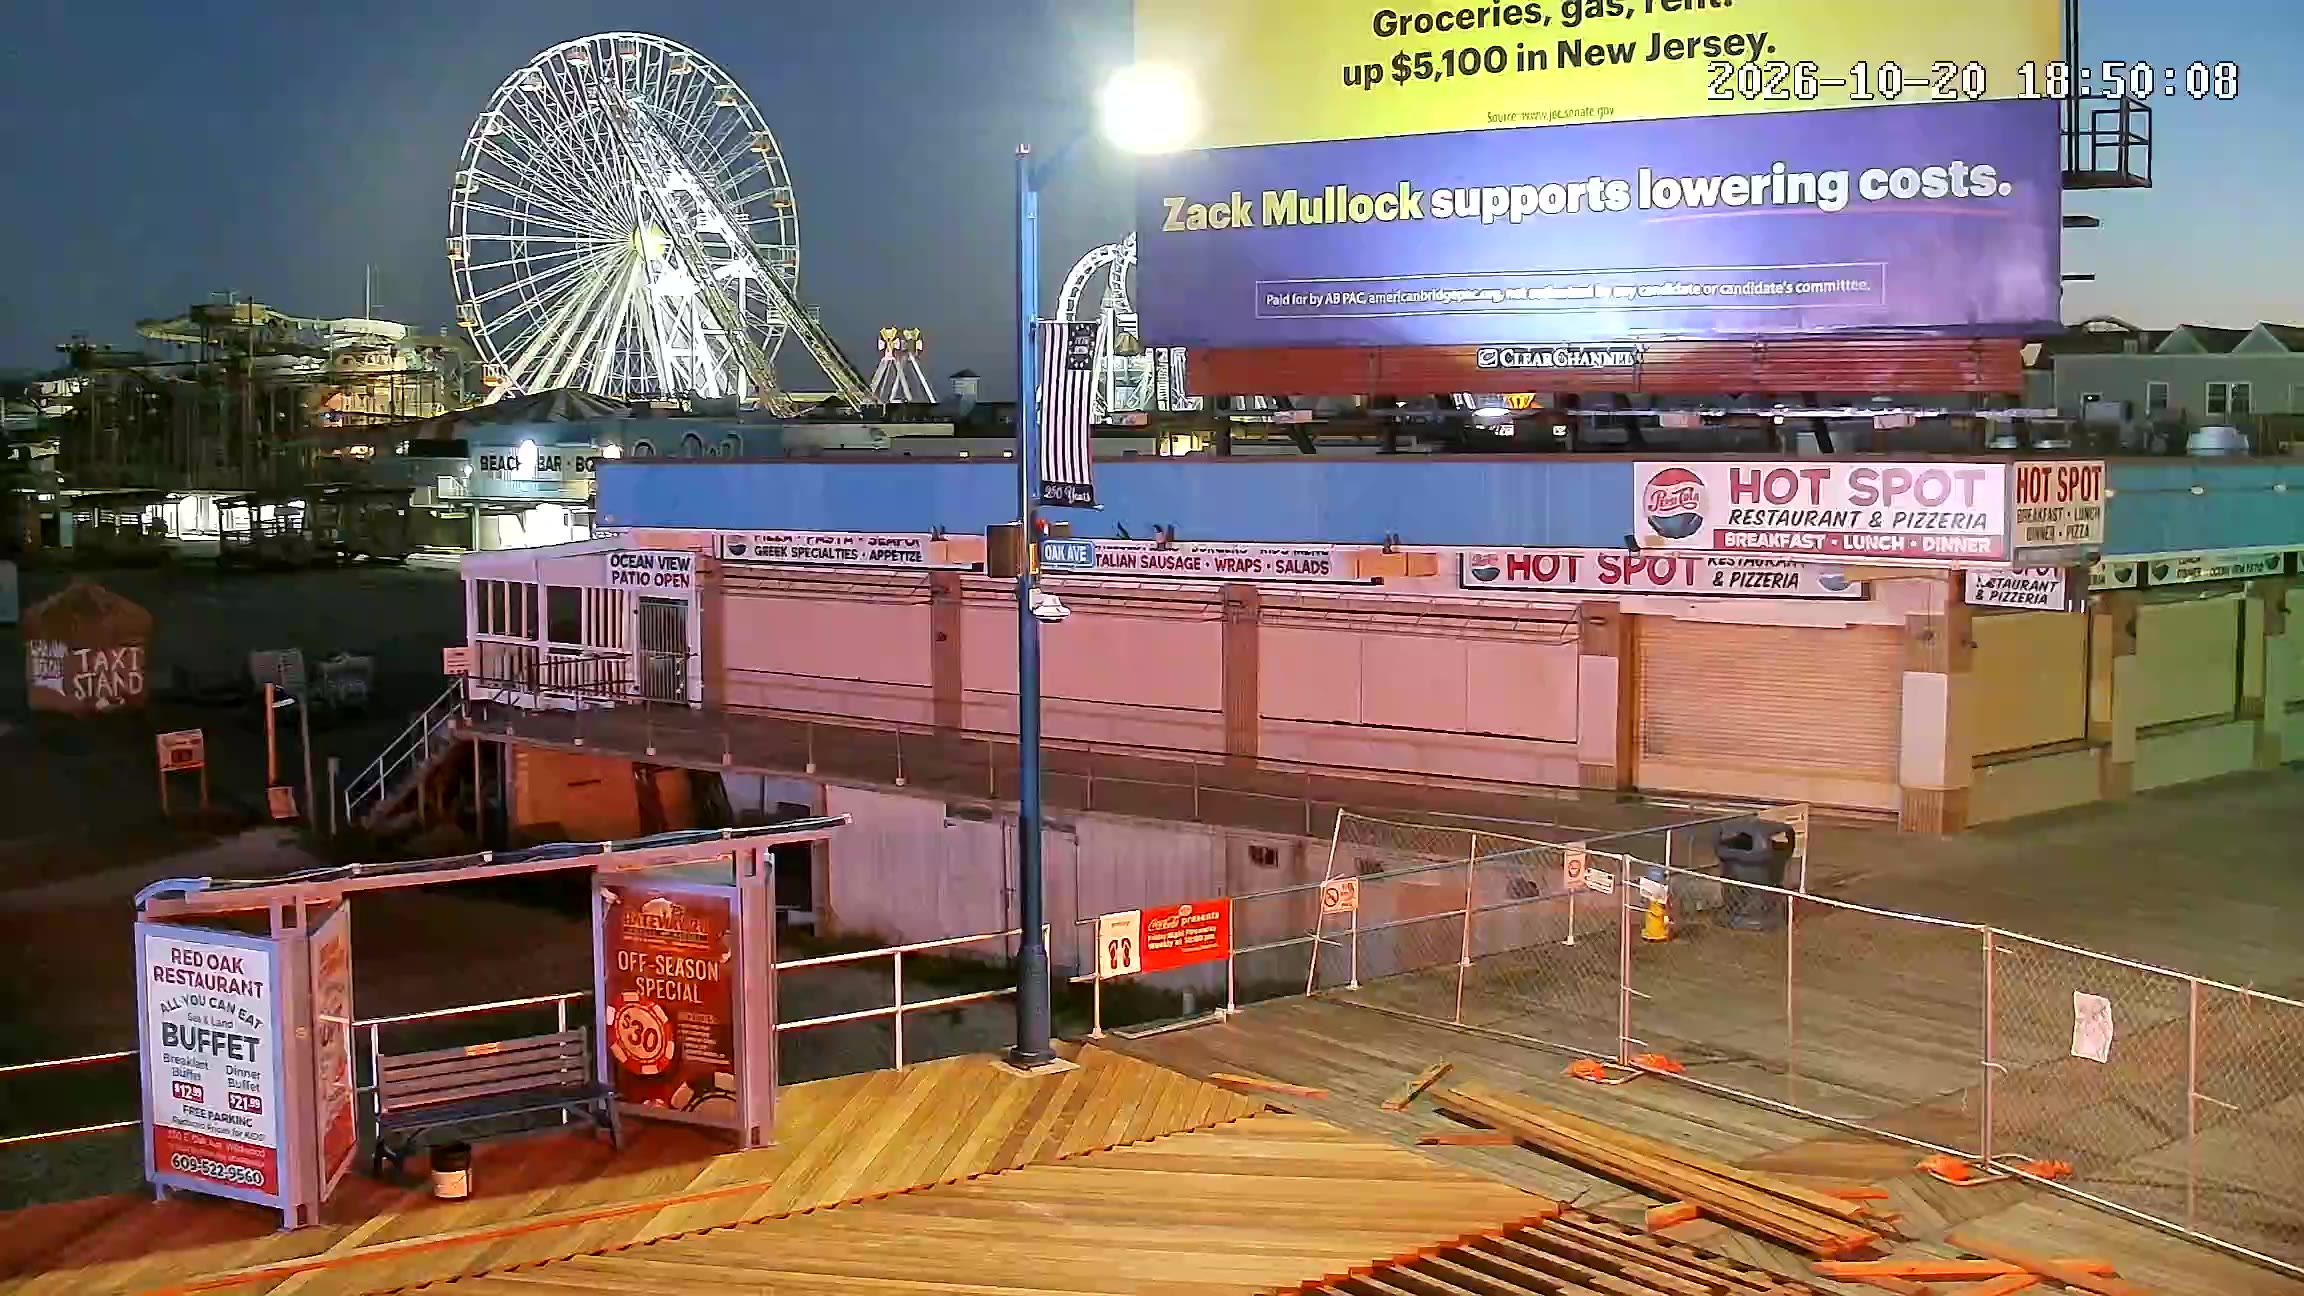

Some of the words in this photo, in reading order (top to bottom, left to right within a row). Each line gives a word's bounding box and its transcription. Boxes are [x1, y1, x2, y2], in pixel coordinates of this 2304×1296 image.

[1373, 0, 1551, 37] Groceries,
[1561, 0, 1635, 28] gas,
[1343, 63, 1383, 91] up
[1392, 46, 1508, 86] $5,100
[1516, 42, 1547, 72] in
[1557, 38, 1636, 69] New
[1645, 32, 1776, 63] Jersey.
[1162, 189, 1255, 232] Zack
[1261, 180, 1425, 228] Mullock
[1431, 175, 1631, 225] supports
[1637, 161, 1850, 212] lowering
[1859, 160, 2012, 200] costs.
[1266, 293, 1290, 306] Paid
[1292, 293, 1308, 305] for
[1309, 292, 1324, 308] by
[1702, 284, 1718, 296] or
[1719, 280, 1793, 296] candidate's
[1795, 279, 1871, 294] committee.
[1729, 467, 1831, 505] HOT
[1848, 467, 1986, 507] SPOT
[2016, 466, 2052, 504] HOT
[2057, 466, 2102, 502] SPOT
[1728, 508, 1863, 528] RESTAURANT
[1868, 511, 1883, 529] &
[1892, 511, 1988, 530] PIZZERIA
[754, 545, 788, 558] GREEK
[791, 547, 858, 560] SPECIALTIES
[1044, 544, 1065, 561] OAK
[1067, 545, 1087, 562] AVE
[1724, 531, 1826, 550] BREAKFAST
[1843, 533, 1905, 552] LUNCH
[1922, 536, 1992, 553] DINNER
[610, 553, 654, 570] OCEAN
[658, 556, 691, 571] VIEW
[1094, 552, 1136, 568] TALIAN
[1140, 554, 1201, 571] SAUSAGE
[1215, 557, 1262, 573] WRAPS
[1275, 559, 1330, 575] SALADS
[1506, 553, 1577, 583] HOT
[1597, 554, 1694, 586] SPOT
[612, 571, 650, 586] PATIO
[654, 573, 690, 588] OPEN
[1712, 571, 1724, 587] &
[1729, 571, 1800, 590] PIZZERIA
[1975, 588, 1984, 601] &
[1989, 590, 2049, 605] PIZZERIA
[72, 647, 140, 673] TAXI
[73, 671, 143, 701] STAND
[170, 947, 204, 968] RED
[206, 953, 244, 975] OAK
[617, 951, 720, 982] OFF-SEASON
[153, 965, 264, 999] RESTAURANT
[635, 976, 704, 1004] SPECIAL
[160, 999, 181, 1014] ALL
[182, 994, 206, 1007] YOU
[208, 997, 236, 1016] CAN
[238, 1008, 264, 1030] EAT
[210, 1015, 233, 1029] Land
[161, 1021, 261, 1063] BUFFET
[621, 1013, 659, 1052] $30
[225, 1065, 261, 1080] Dinner
[228, 1078, 260, 1092] Buffet
[182, 1104, 207, 1119] FREE
[207, 1111, 253, 1128] PARKING
[171, 1153, 265, 1186] 609-522-9560
